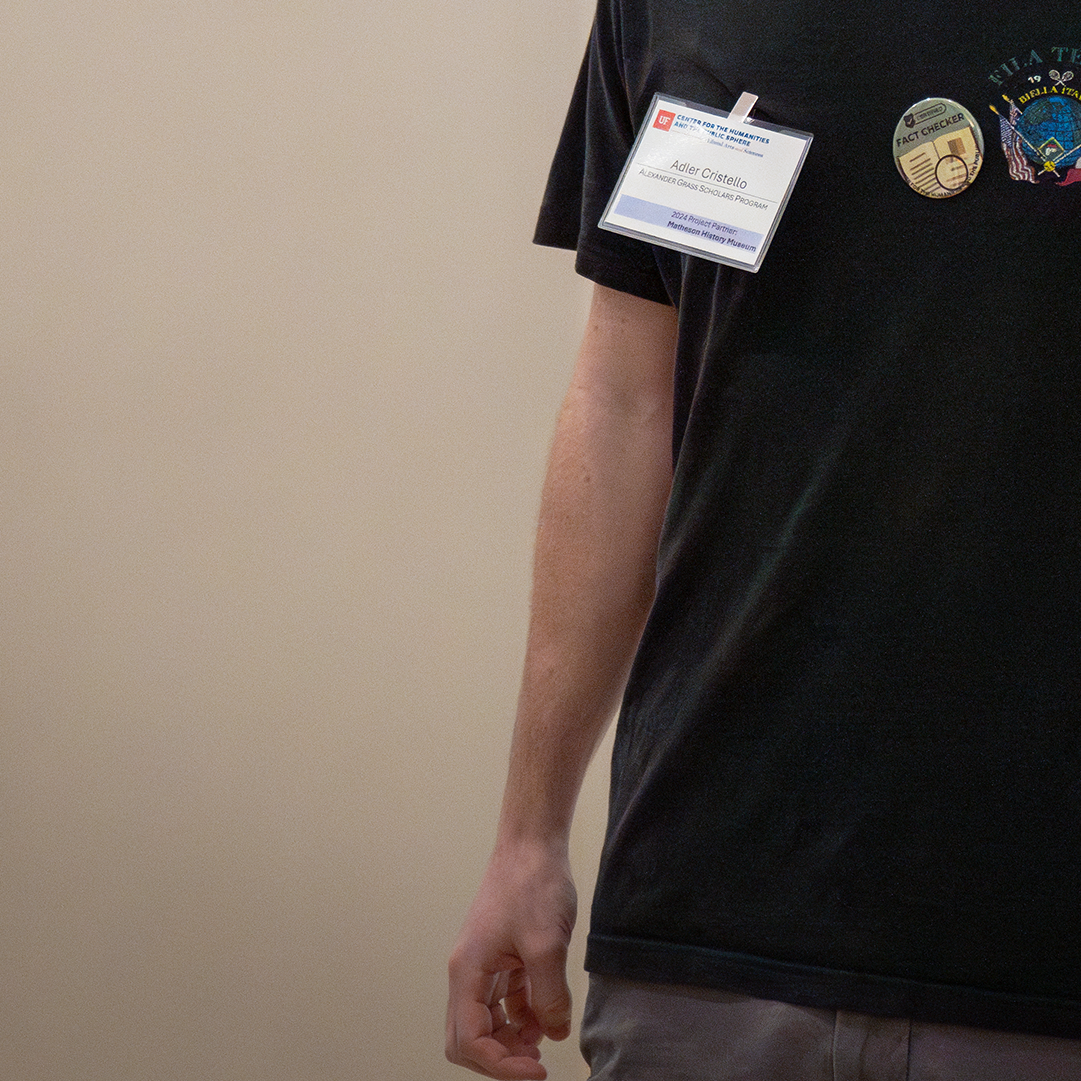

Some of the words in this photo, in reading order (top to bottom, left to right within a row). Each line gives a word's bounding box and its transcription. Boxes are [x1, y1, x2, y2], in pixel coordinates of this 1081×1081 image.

[988, 49, 1043, 86] FILA
[1027, 75, 1042, 84] 19
[674, 121, 689, 130] AND
[726, 135, 751, 147] SPHERE
[677, 114, 701, 126] CENTER
[702, 121, 715, 132] FOR
[716, 125, 729, 133] THE
[729, 129, 770, 145] HUMANITIES
[896, 131, 919, 147] FACT
[920, 112, 965, 136] CHECKER
[638, 168, 676, 185] ALEXANDER
[677, 179, 699, 191] GRASS
[699, 185, 735, 201] SCHOLARS
[735, 195, 769, 210] PROGRAM
[670, 159, 700, 176] Adler
[701, 168, 747, 189] Cristello
[667, 221, 701, 236] Matheson
[701, 230, 727, 245] History
[727, 237, 757, 253] Museum
[671, 211, 688, 221] 2024
[688, 215, 711, 228] Project
[711, 222, 738, 236] Partner:
